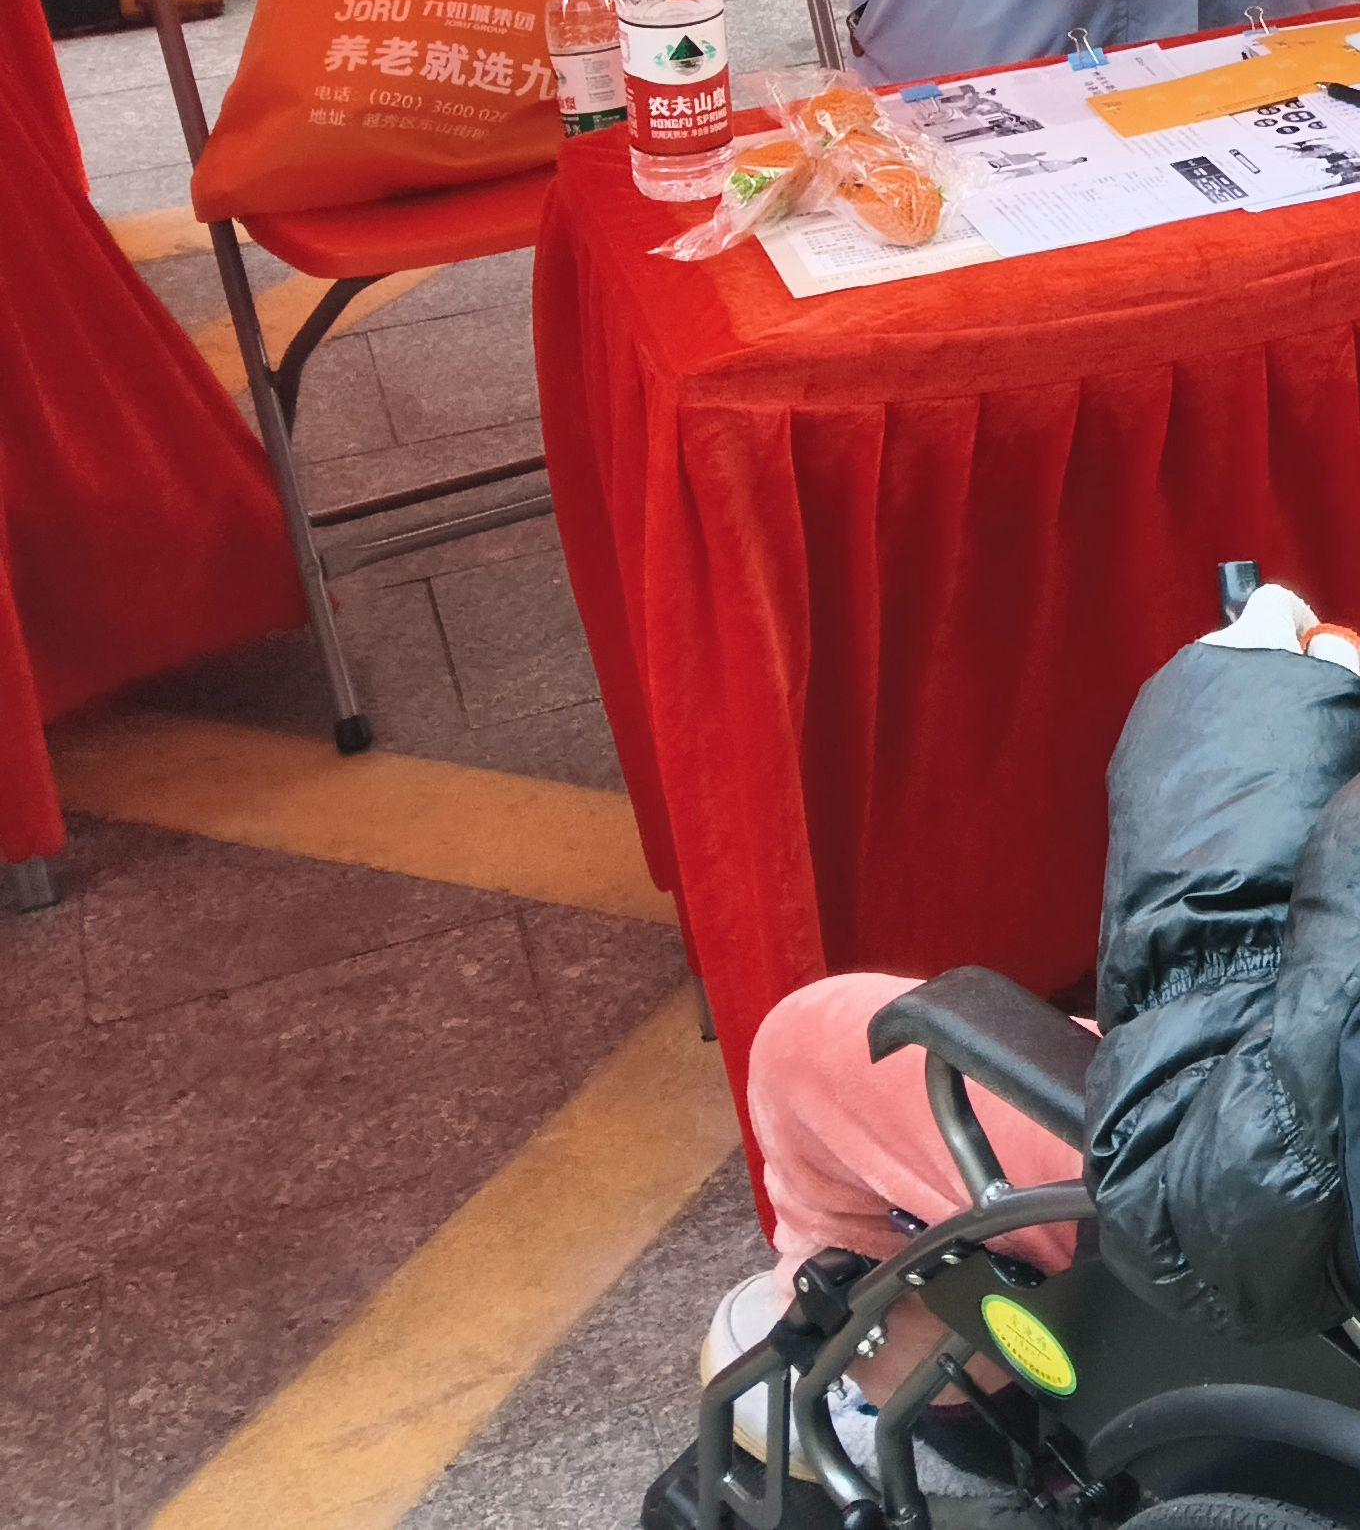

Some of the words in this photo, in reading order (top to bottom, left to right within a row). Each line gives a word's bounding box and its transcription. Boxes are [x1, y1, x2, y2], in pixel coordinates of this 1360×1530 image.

[334, 0, 412, 21] JORU
[324, 34, 557, 101] 养老就选九
[432, 100, 475, 119] 3600
[648, 87, 727, 117] 农夫山泉
[650, 117, 693, 129] NONGFU
